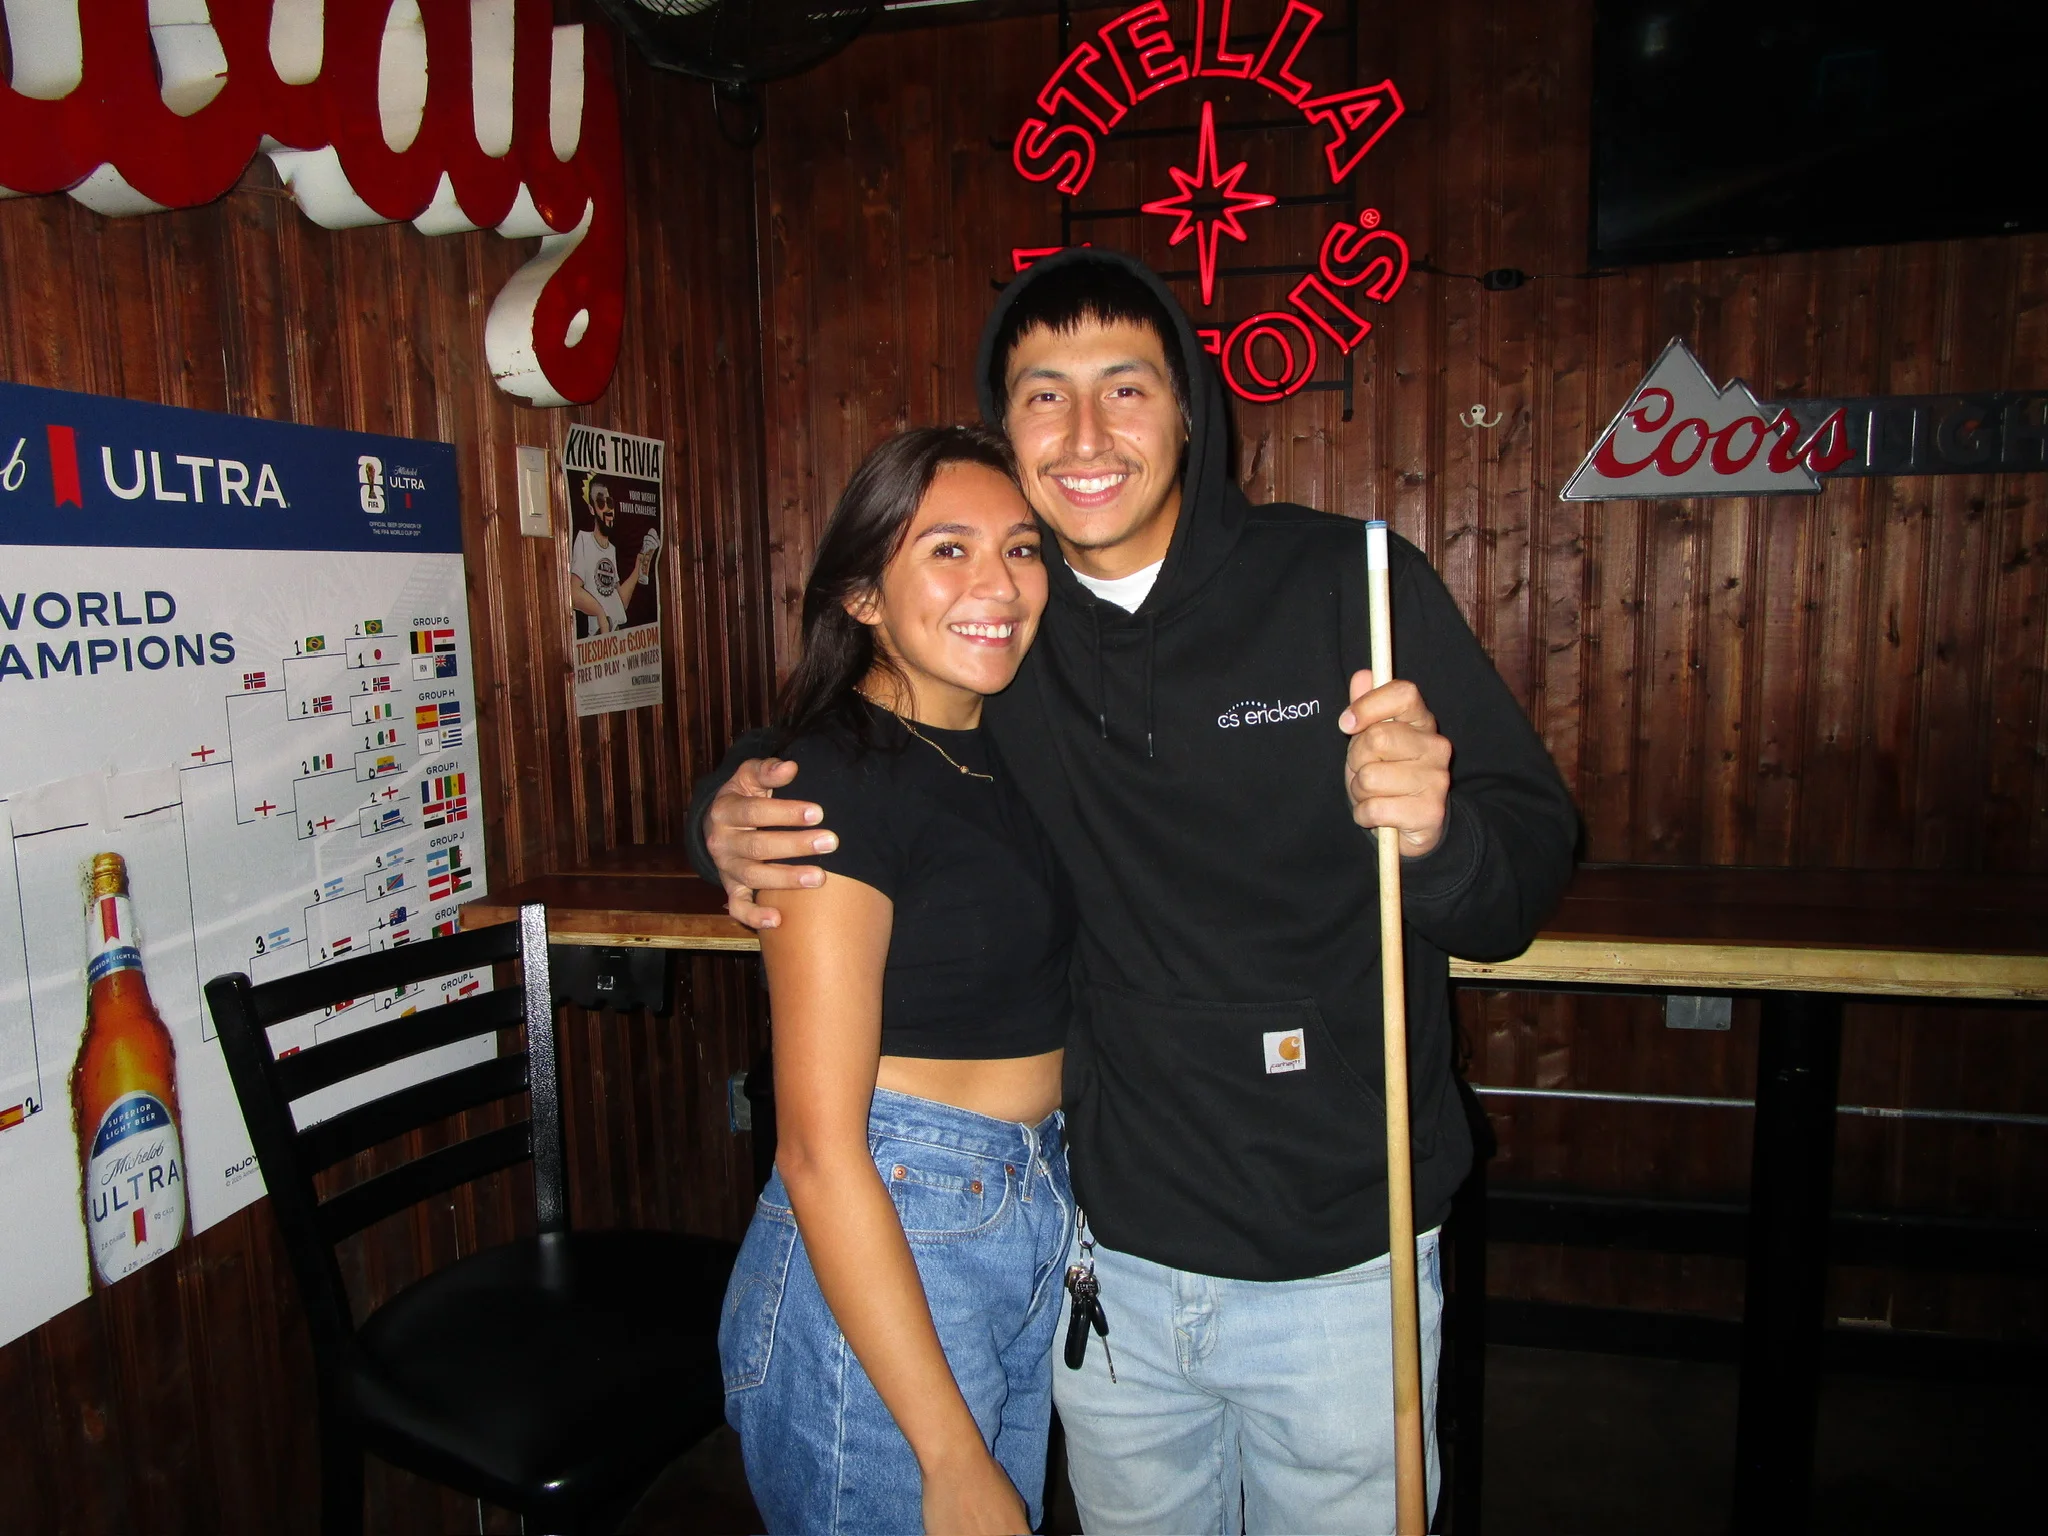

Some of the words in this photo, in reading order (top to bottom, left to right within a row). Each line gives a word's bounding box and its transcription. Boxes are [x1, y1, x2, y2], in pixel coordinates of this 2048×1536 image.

[1013, 0, 1405, 195] STELLA
[1592, 387, 1857, 478] Coors
[566, 429, 607, 470] KING
[611, 436, 660, 479] TRIVIA
[101, 445, 290, 509] ULTRA
[389, 476, 426, 490] ULTRA
[367, 500, 379, 508] FIFA
[619, 501, 634, 514] TRIVIA
[634, 504, 657, 517] CHALLENGE
[413, 617, 442, 626] GROUP
[443, 616, 450, 625] G
[576, 635, 619, 666] TUESDAYS
[619, 639, 627, 656] AT
[627, 629, 646, 652] 6:00
[646, 626, 660, 647] PM
[420, 664, 428, 672] IRN
[577, 666, 592, 684] FREE
[593, 664, 603, 680] TO
[604, 660, 621, 677] PLAY
[626, 654, 640, 671] WIN
[640, 648, 660, 668] PRIZES
[418, 690, 448, 701] GROUP
[448, 688, 456, 697] H
[1218, 713, 1240, 728] cs
[1245, 699, 1320, 725] erickson
[424, 738, 434, 746] KSA
[426, 763, 454, 775] GROUP
[430, 833, 459, 848] GROUP
[459, 831, 466, 839] J
[434, 903, 463, 921] GROU
[255, 935, 266, 954] 3
[440, 973, 468, 992] GROUP
[468, 971, 475, 979] L
[25, 1096, 40, 1115] 2
[108, 1103, 151, 1128] SUPERIOR
[105, 1121, 132, 1141] LIGHT
[134, 1112, 157, 1127] BEER
[101, 1139, 164, 1186] Michelob
[224, 1154, 259, 1178] ENJOY
[93, 1158, 180, 1223] ULTRA
